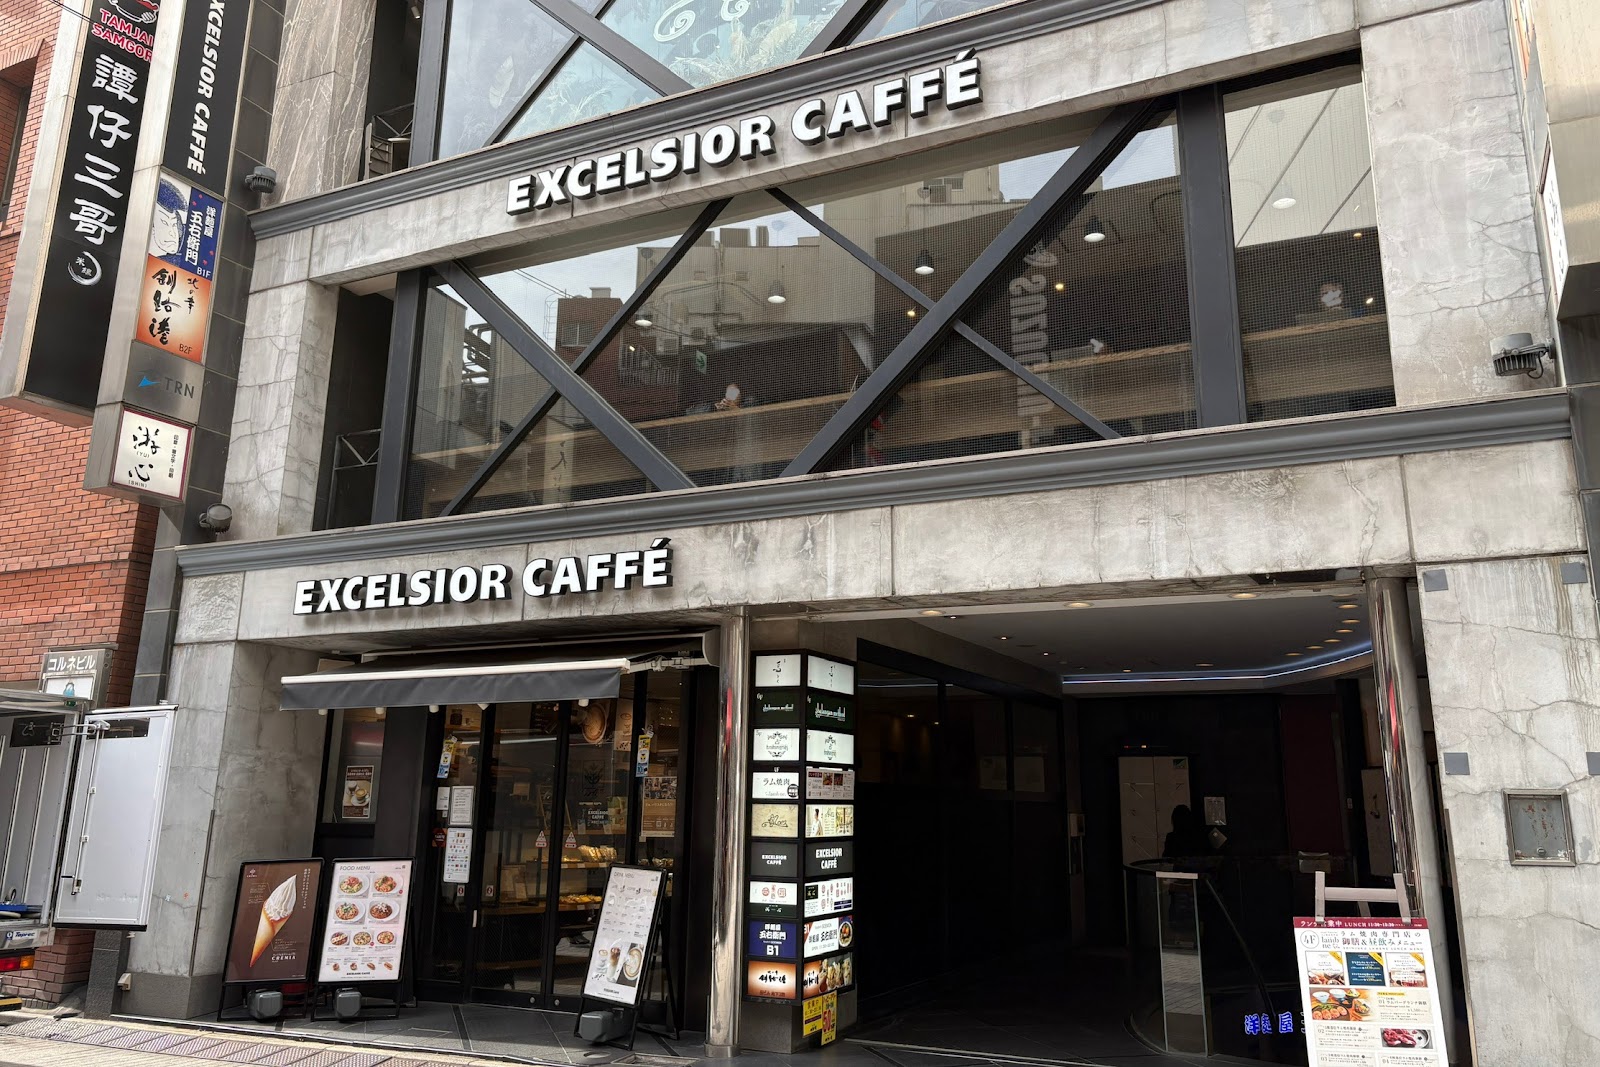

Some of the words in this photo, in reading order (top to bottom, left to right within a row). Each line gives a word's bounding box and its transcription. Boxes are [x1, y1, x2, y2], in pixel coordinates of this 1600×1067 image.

[99, 8, 154, 47] TAMJAI
[91, 24, 153, 62] SAMGOR
[196, 0, 226, 99] XCELSIOR
[186, 102, 211, 175] CAFFÉ
[506, 114, 779, 216] EXCELSIOR
[790, 47, 983, 146] CAFFÉ
[69, 53, 139, 246] 譚仔三哥
[196, 266, 211, 278] B1F
[179, 344, 193, 354] B2F
[164, 376, 195, 398] TRN
[293, 563, 512, 615] EXCELSIOR
[521, 537, 673, 598] CAFFÉ
[48, 655, 96, 671] コルネビル
[763, 778, 790, 786] ラム焼肉
[816, 848, 843, 859] EXCELSIOR
[821, 858, 837, 869] CAFFÉ
[767, 945, 779, 955] B1
